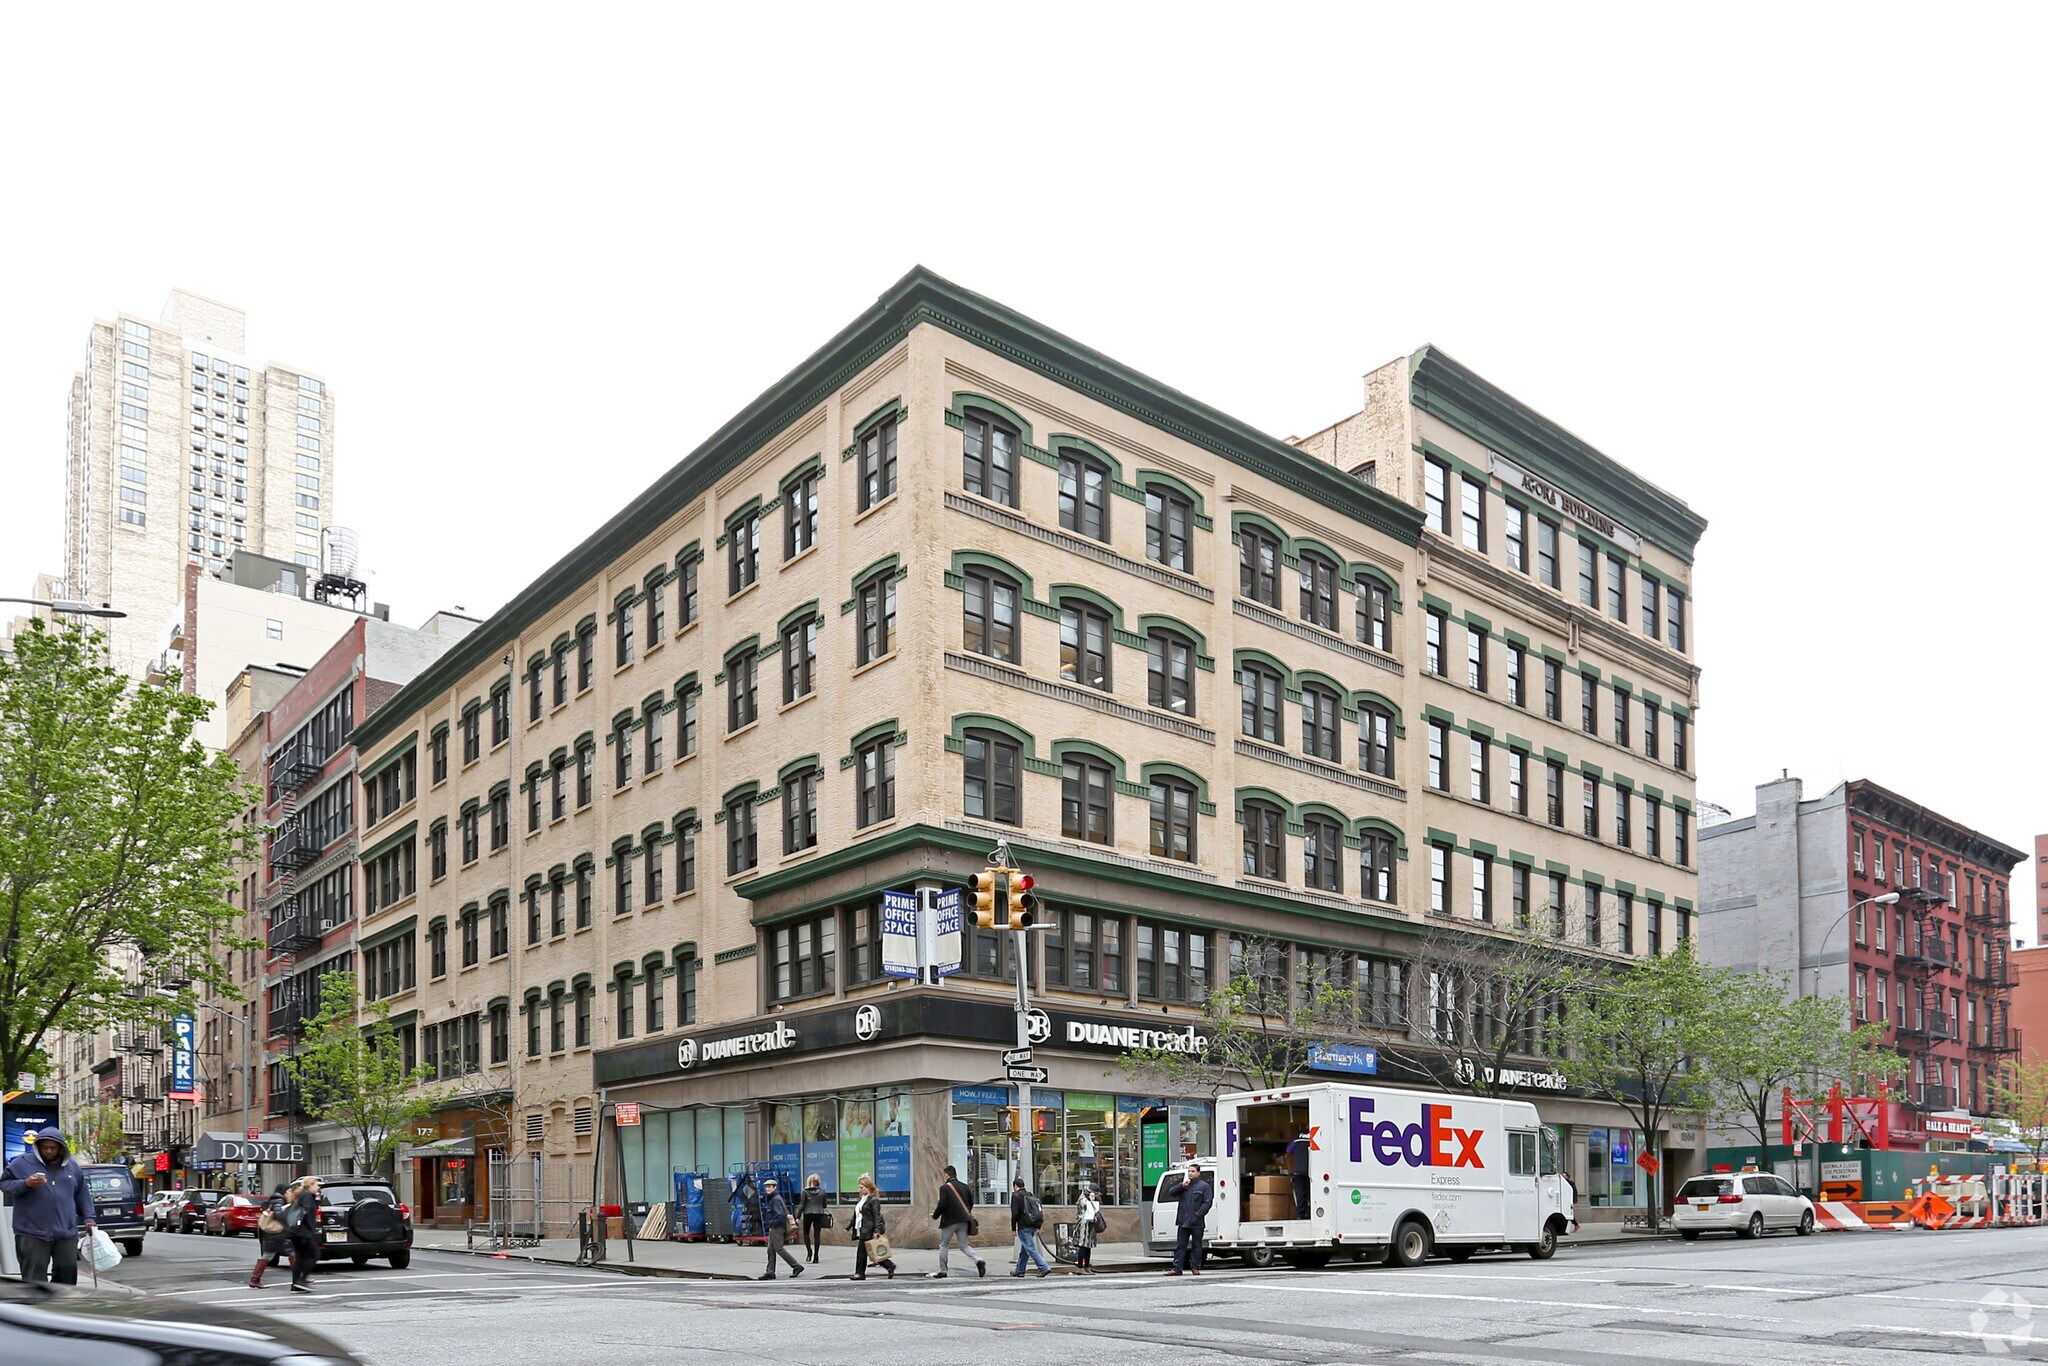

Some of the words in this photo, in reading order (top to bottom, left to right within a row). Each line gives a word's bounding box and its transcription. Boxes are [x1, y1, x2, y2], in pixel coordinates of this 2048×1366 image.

[1521, 475, 1556, 505] AGORA
[1560, 495, 1615, 538] BUILDING
[885, 895, 915, 910] PRIME
[937, 893, 958, 909] PRIME
[885, 908, 915, 923] OFFICE
[937, 906, 958, 921] OFFICE
[884, 920, 915, 935] SPACE
[937, 918, 959, 934] SPACE
[176, 1022, 191, 1079] PARK
[1006, 1053, 1016, 1061] ONE
[1030, 1071, 1042, 1079] WAY
[959, 1090, 976, 1098] HOW
[1349, 1096, 1485, 1169] FedEx
[1926, 1120, 1942, 1132] HALE
[1948, 1122, 1971, 1134] HEARTY
[221, 1143, 304, 1161] DOYLE
[878, 1143, 903, 1155] pharmacy
[1431, 1173, 1460, 1185] Express
[1432, 1192, 1462, 1202] fedex.com
